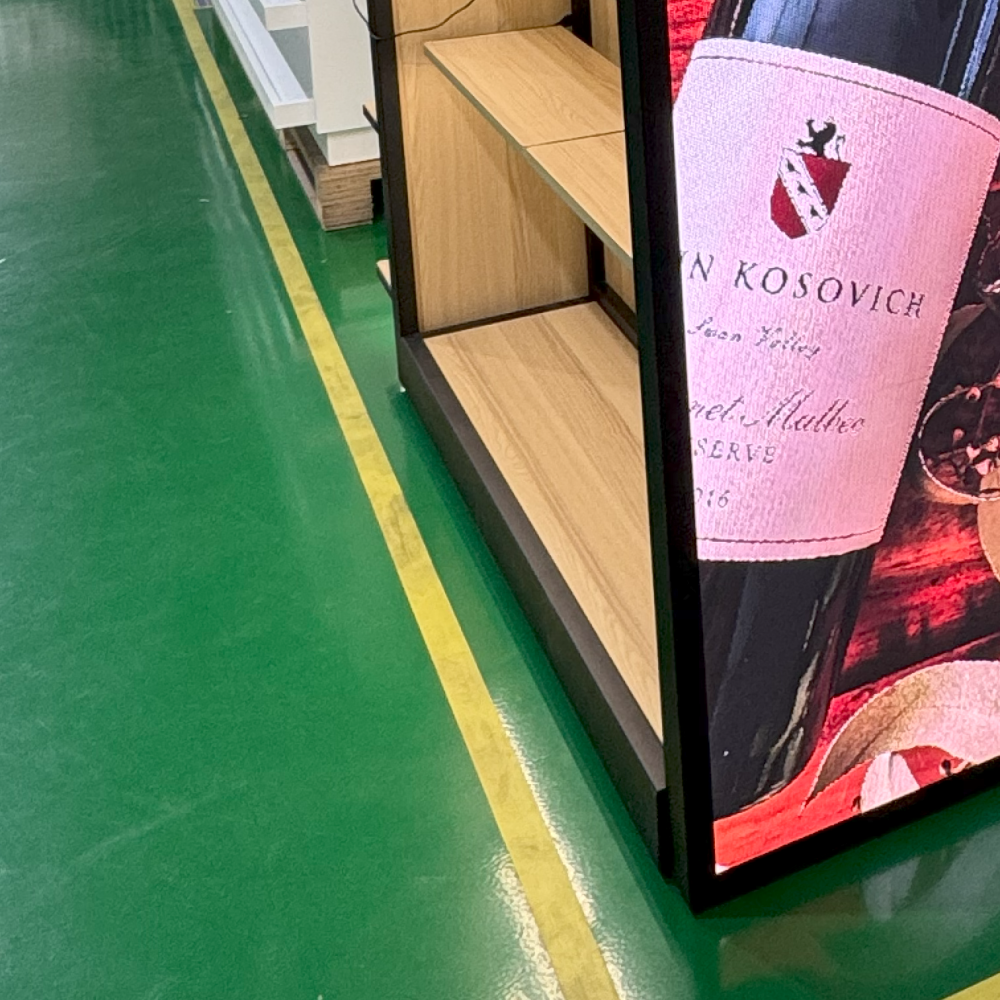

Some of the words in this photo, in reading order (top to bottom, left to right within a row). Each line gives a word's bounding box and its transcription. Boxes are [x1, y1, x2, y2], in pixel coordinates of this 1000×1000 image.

[681, 250, 715, 282] N
[734, 259, 926, 319] KOSOVICH
[694, 438, 777, 464] SERVE
